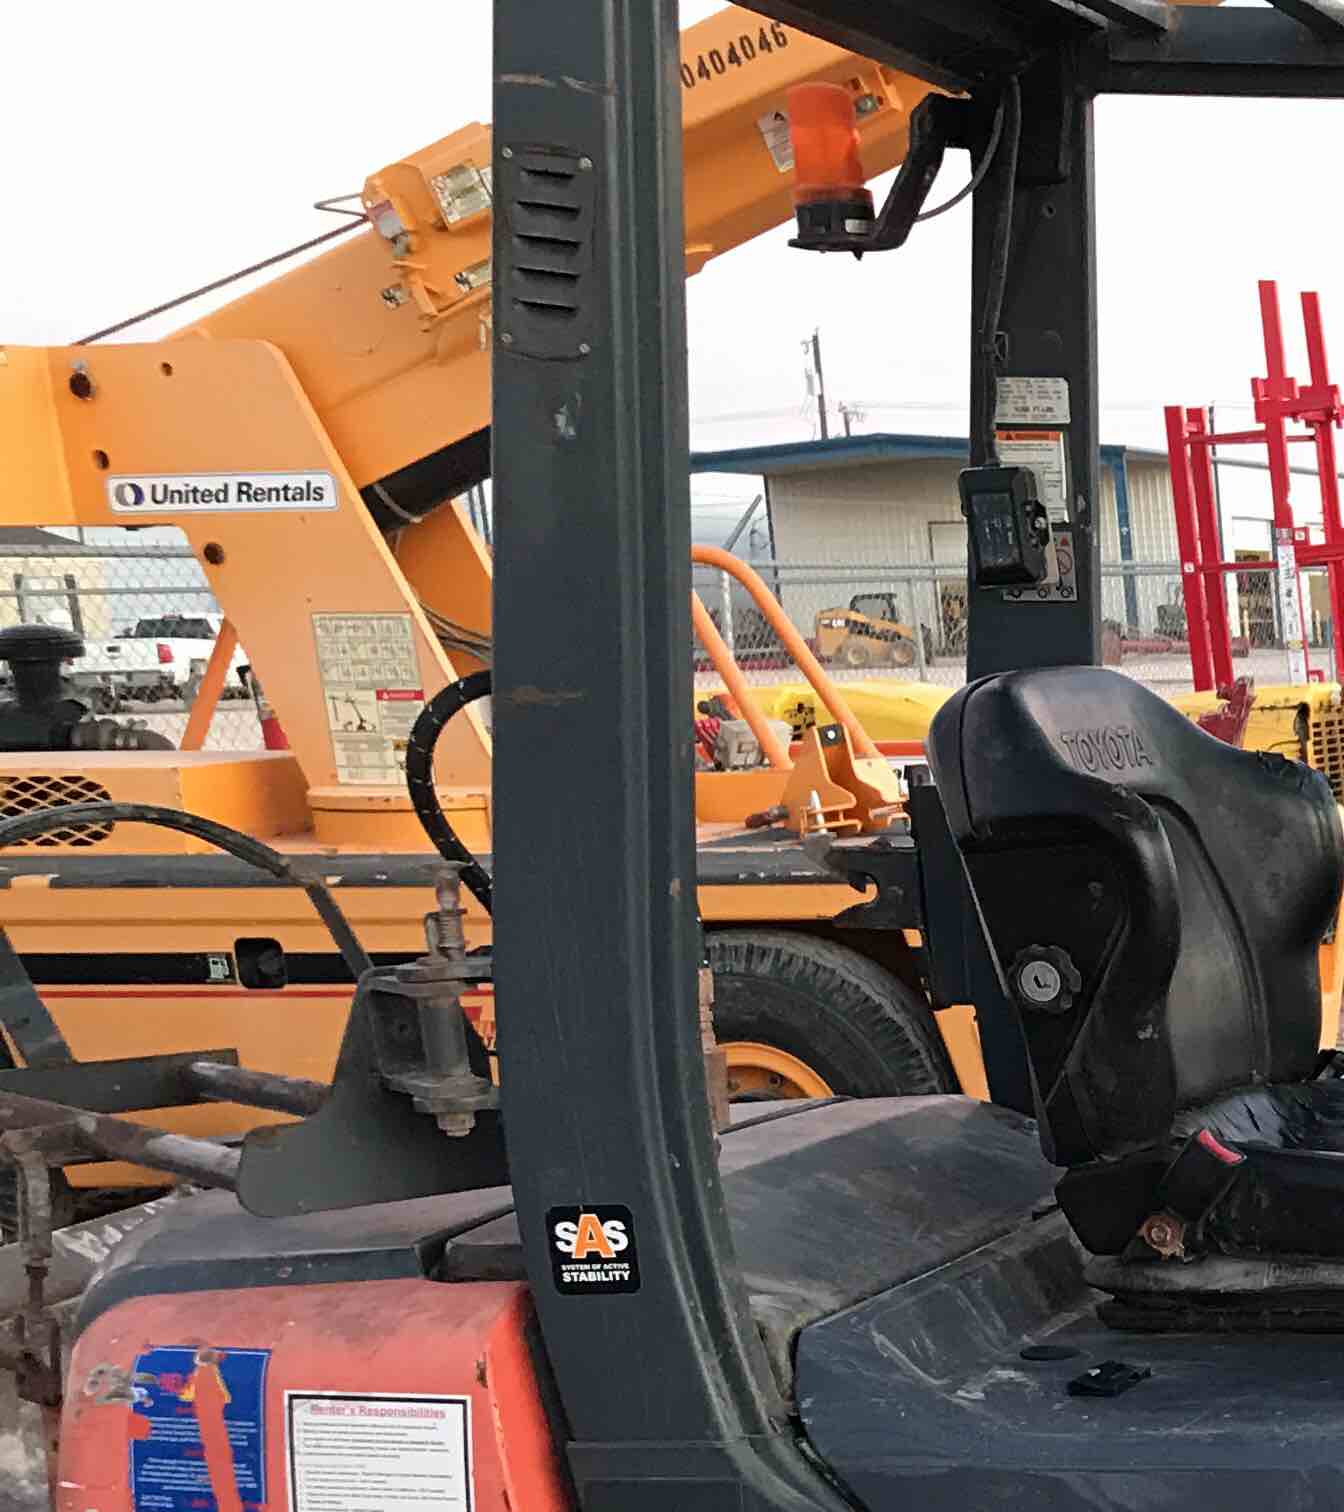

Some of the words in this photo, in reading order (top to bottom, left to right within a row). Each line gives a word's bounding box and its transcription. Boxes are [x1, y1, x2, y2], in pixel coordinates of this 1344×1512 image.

[151, 482, 229, 505] United
[236, 480, 325, 503] Rentals
[1060, 728, 1153, 772] TOYOTA
[554, 1213, 629, 1259] SAS
[561, 1263, 591, 1271] SYSTEM
[562, 1270, 631, 1282] STABILITY
[358, 1405, 447, 1419] Responsibilities
